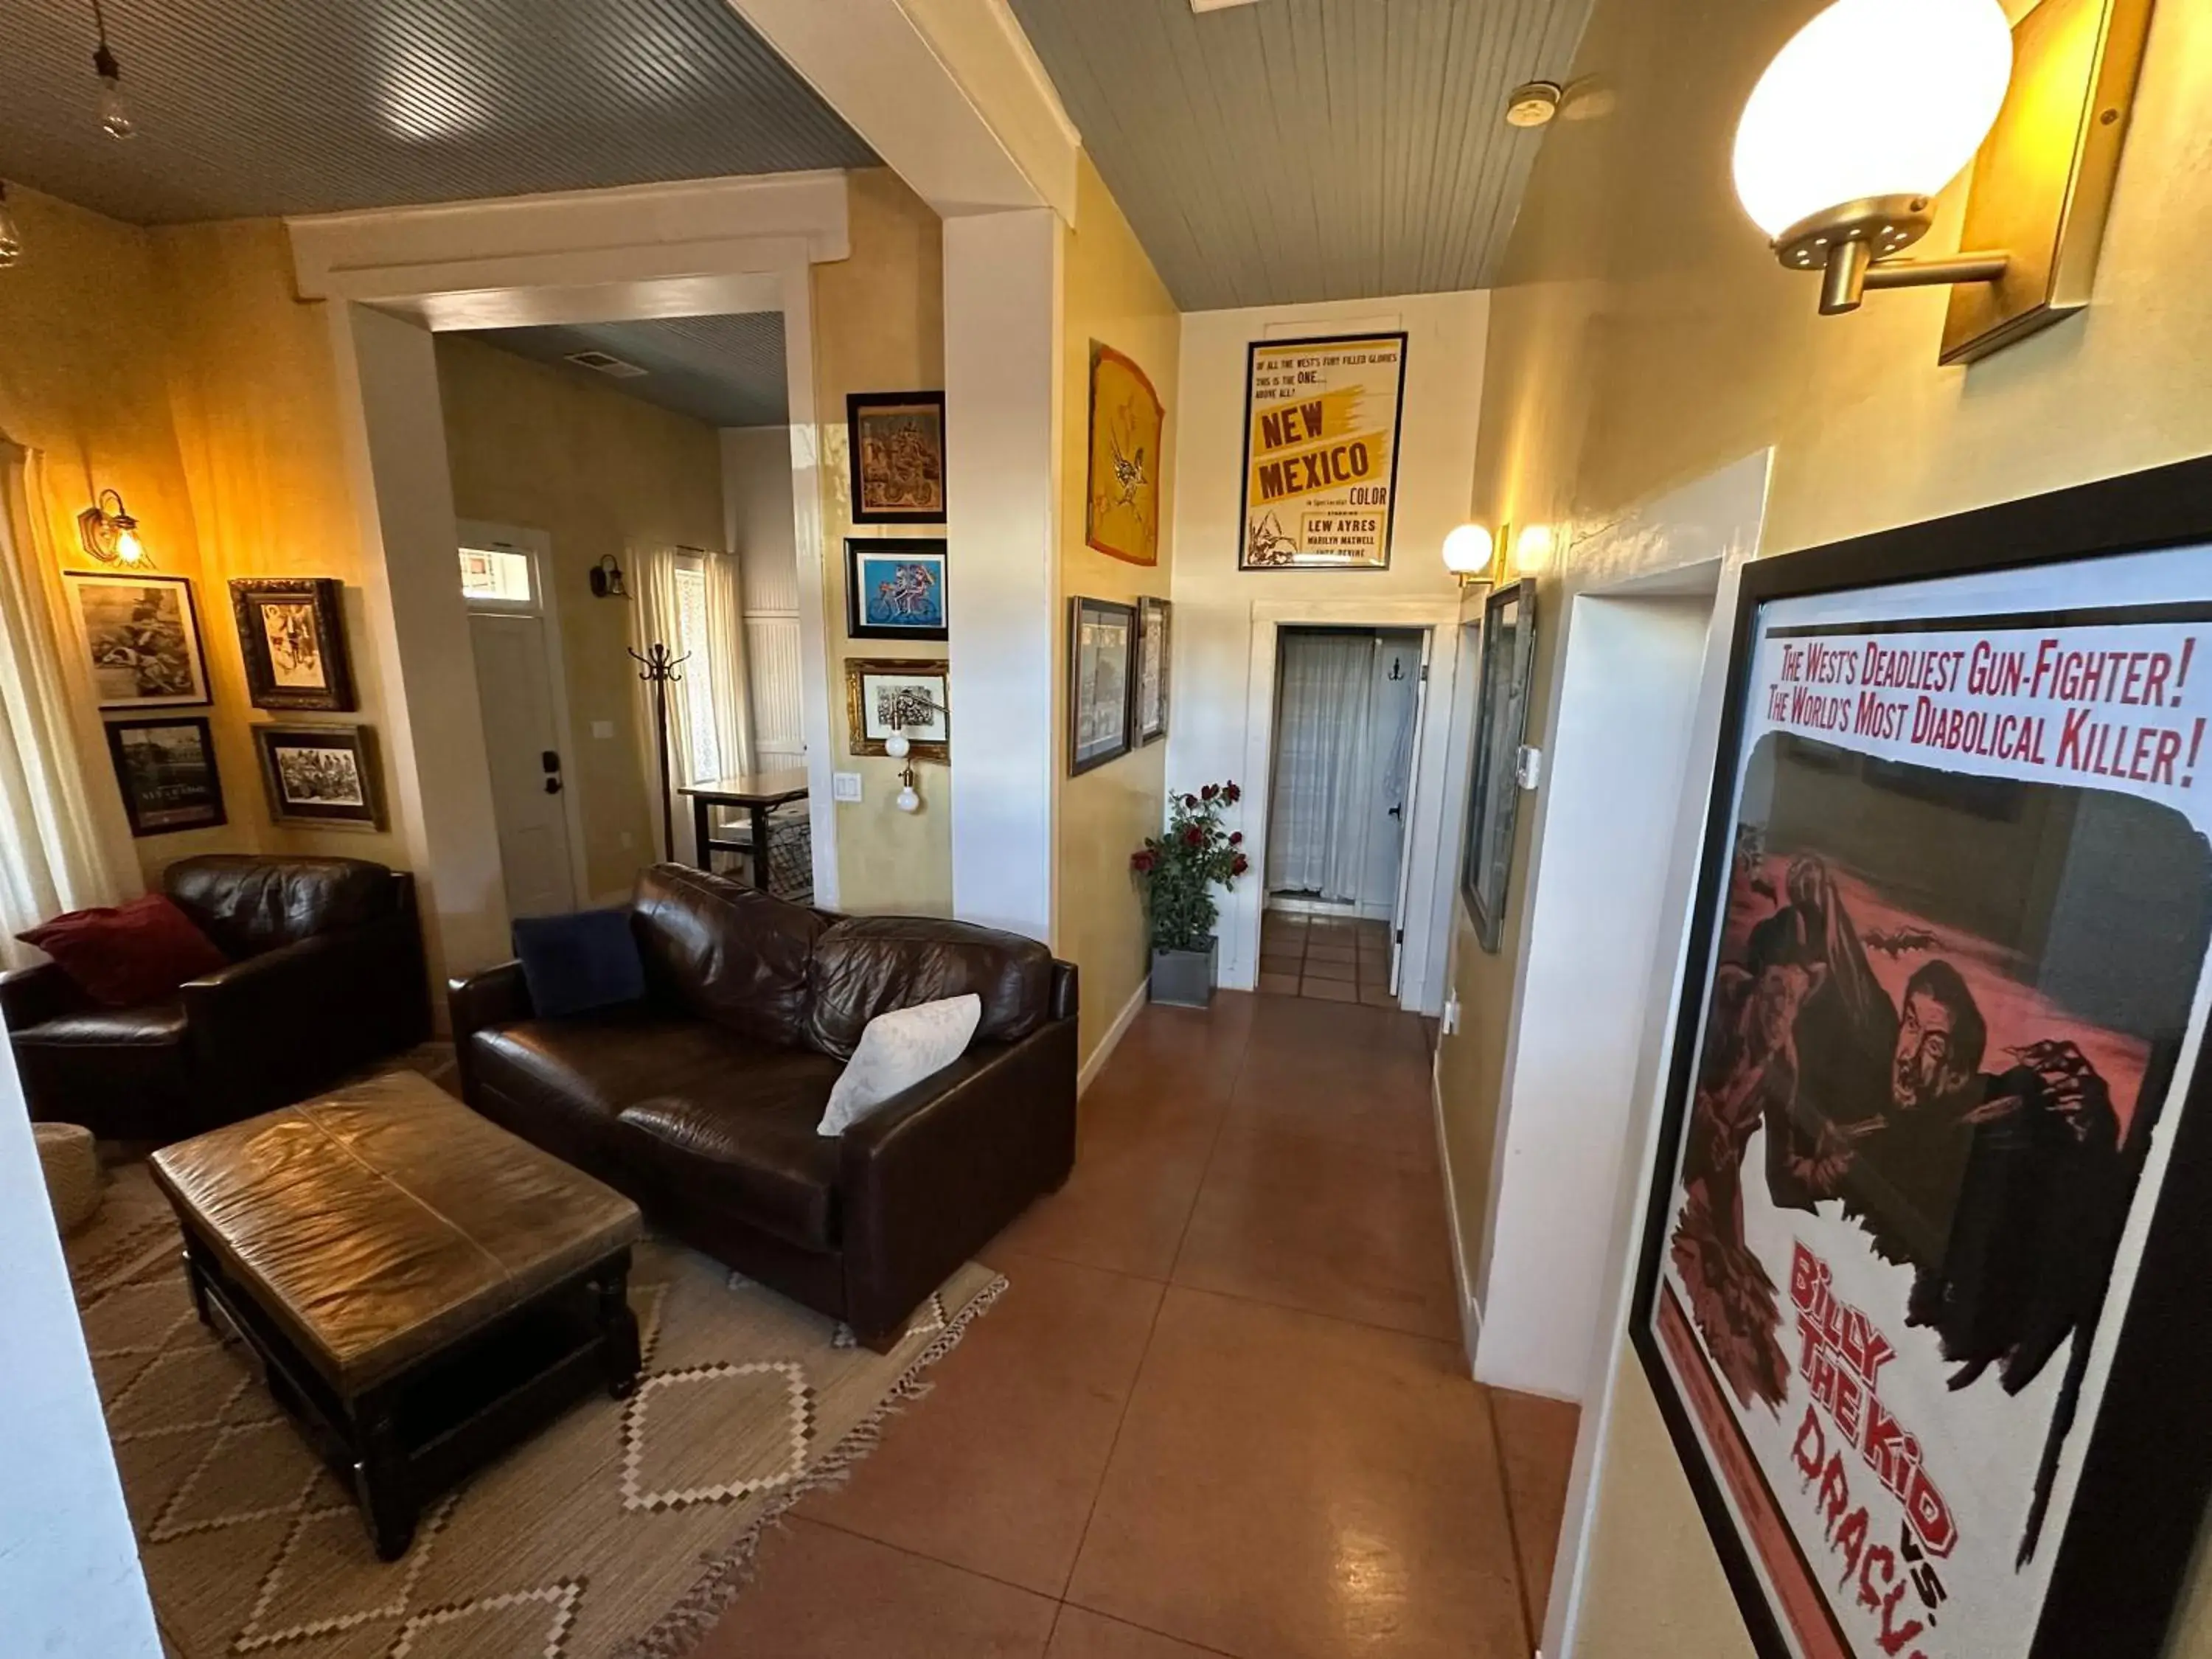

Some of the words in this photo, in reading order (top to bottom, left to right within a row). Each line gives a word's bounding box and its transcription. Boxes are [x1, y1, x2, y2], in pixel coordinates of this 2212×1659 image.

[1267, 361, 1278, 369] ALL
[1281, 359, 1293, 368] THE
[1297, 358, 1320, 367] WEST'S
[1343, 355, 1366, 364] FILLED
[1273, 377, 1279, 385] IS
[1283, 375, 1295, 385] THE
[1256, 389, 1276, 398] ABOVE
[1262, 400, 1323, 448] NEW
[1259, 442, 1368, 499] MEXICO
[1350, 487, 1387, 505] COLOR
[1308, 520, 1332, 532] LEW
[1337, 519, 1375, 532] AYRES
[1307, 536, 1338, 544] MARILYN
[1340, 536, 1374, 545] MAXWELL
[1795, 1311, 1861, 1451] THE
[1790, 1403, 1928, 1659] DRACU
